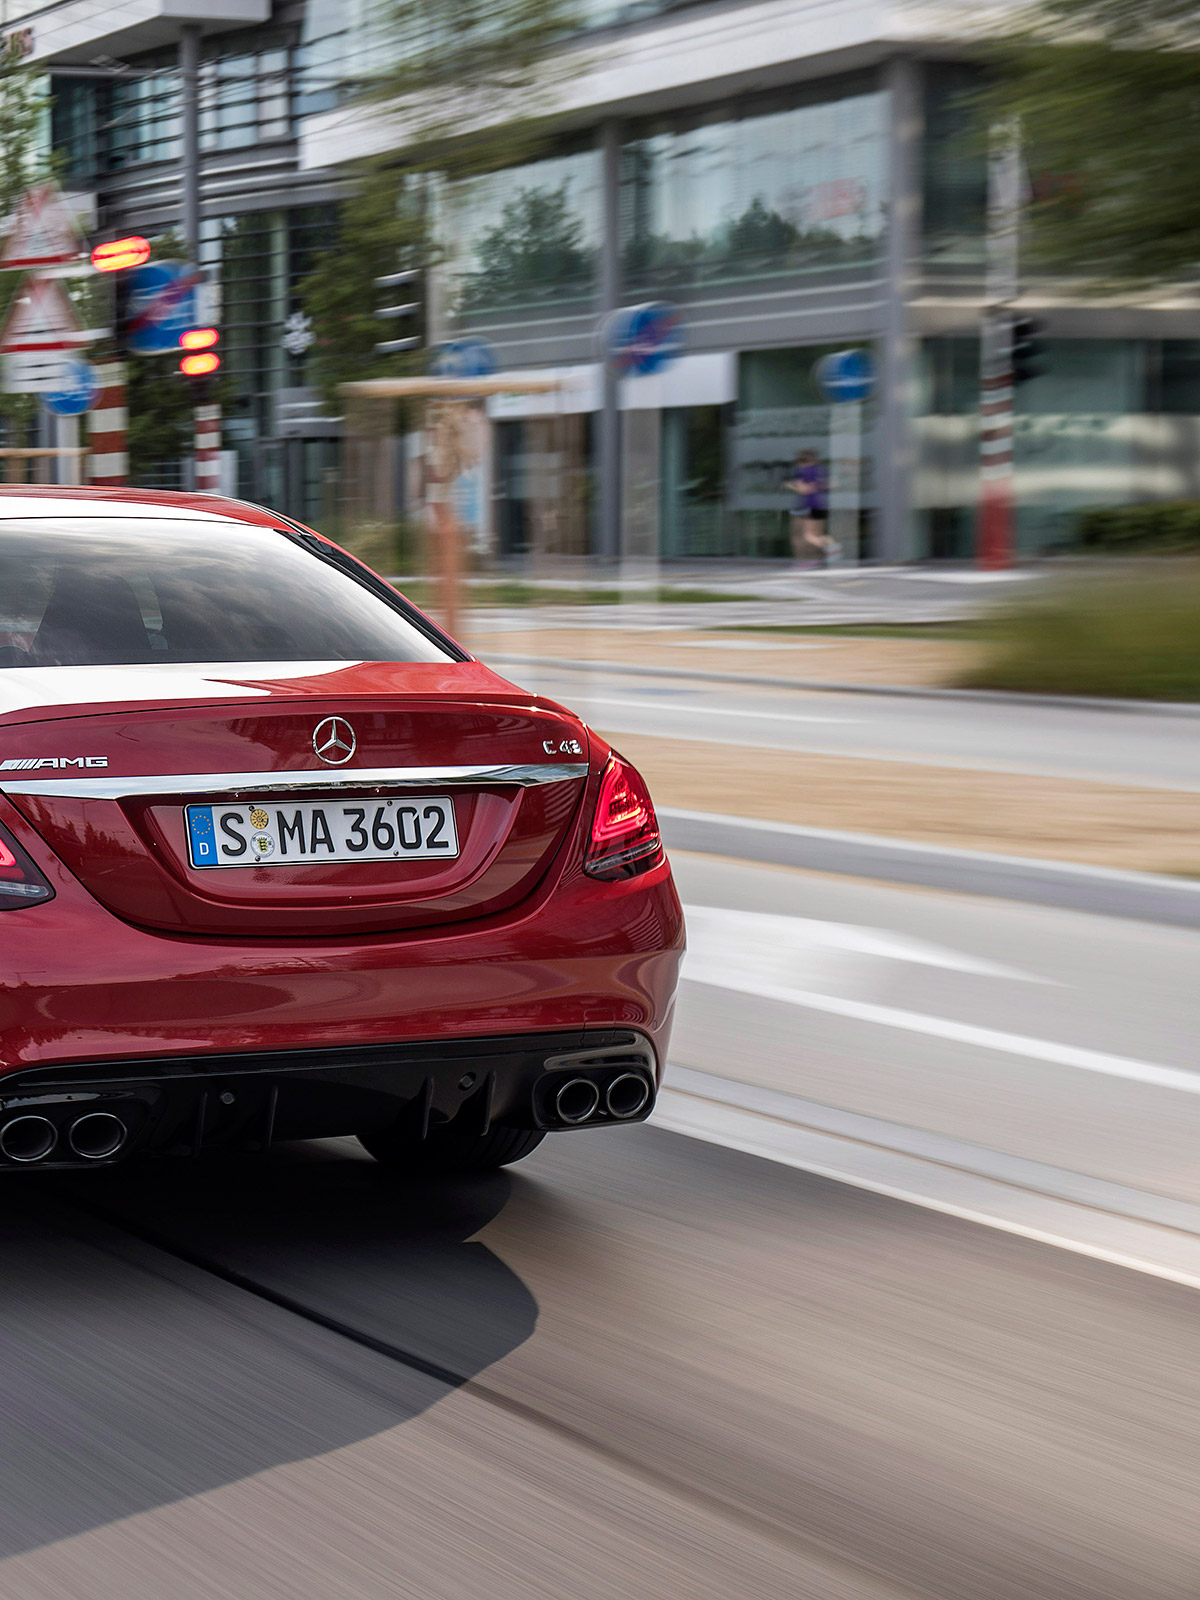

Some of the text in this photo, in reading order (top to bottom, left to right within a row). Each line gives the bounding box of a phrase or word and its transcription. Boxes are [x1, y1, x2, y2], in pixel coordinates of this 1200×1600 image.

[542, 739, 583, 755] C 43
[32, 756, 108, 770] AMG
[219, 806, 449, 856] S MA 3602
[200, 842, 210, 856] D
